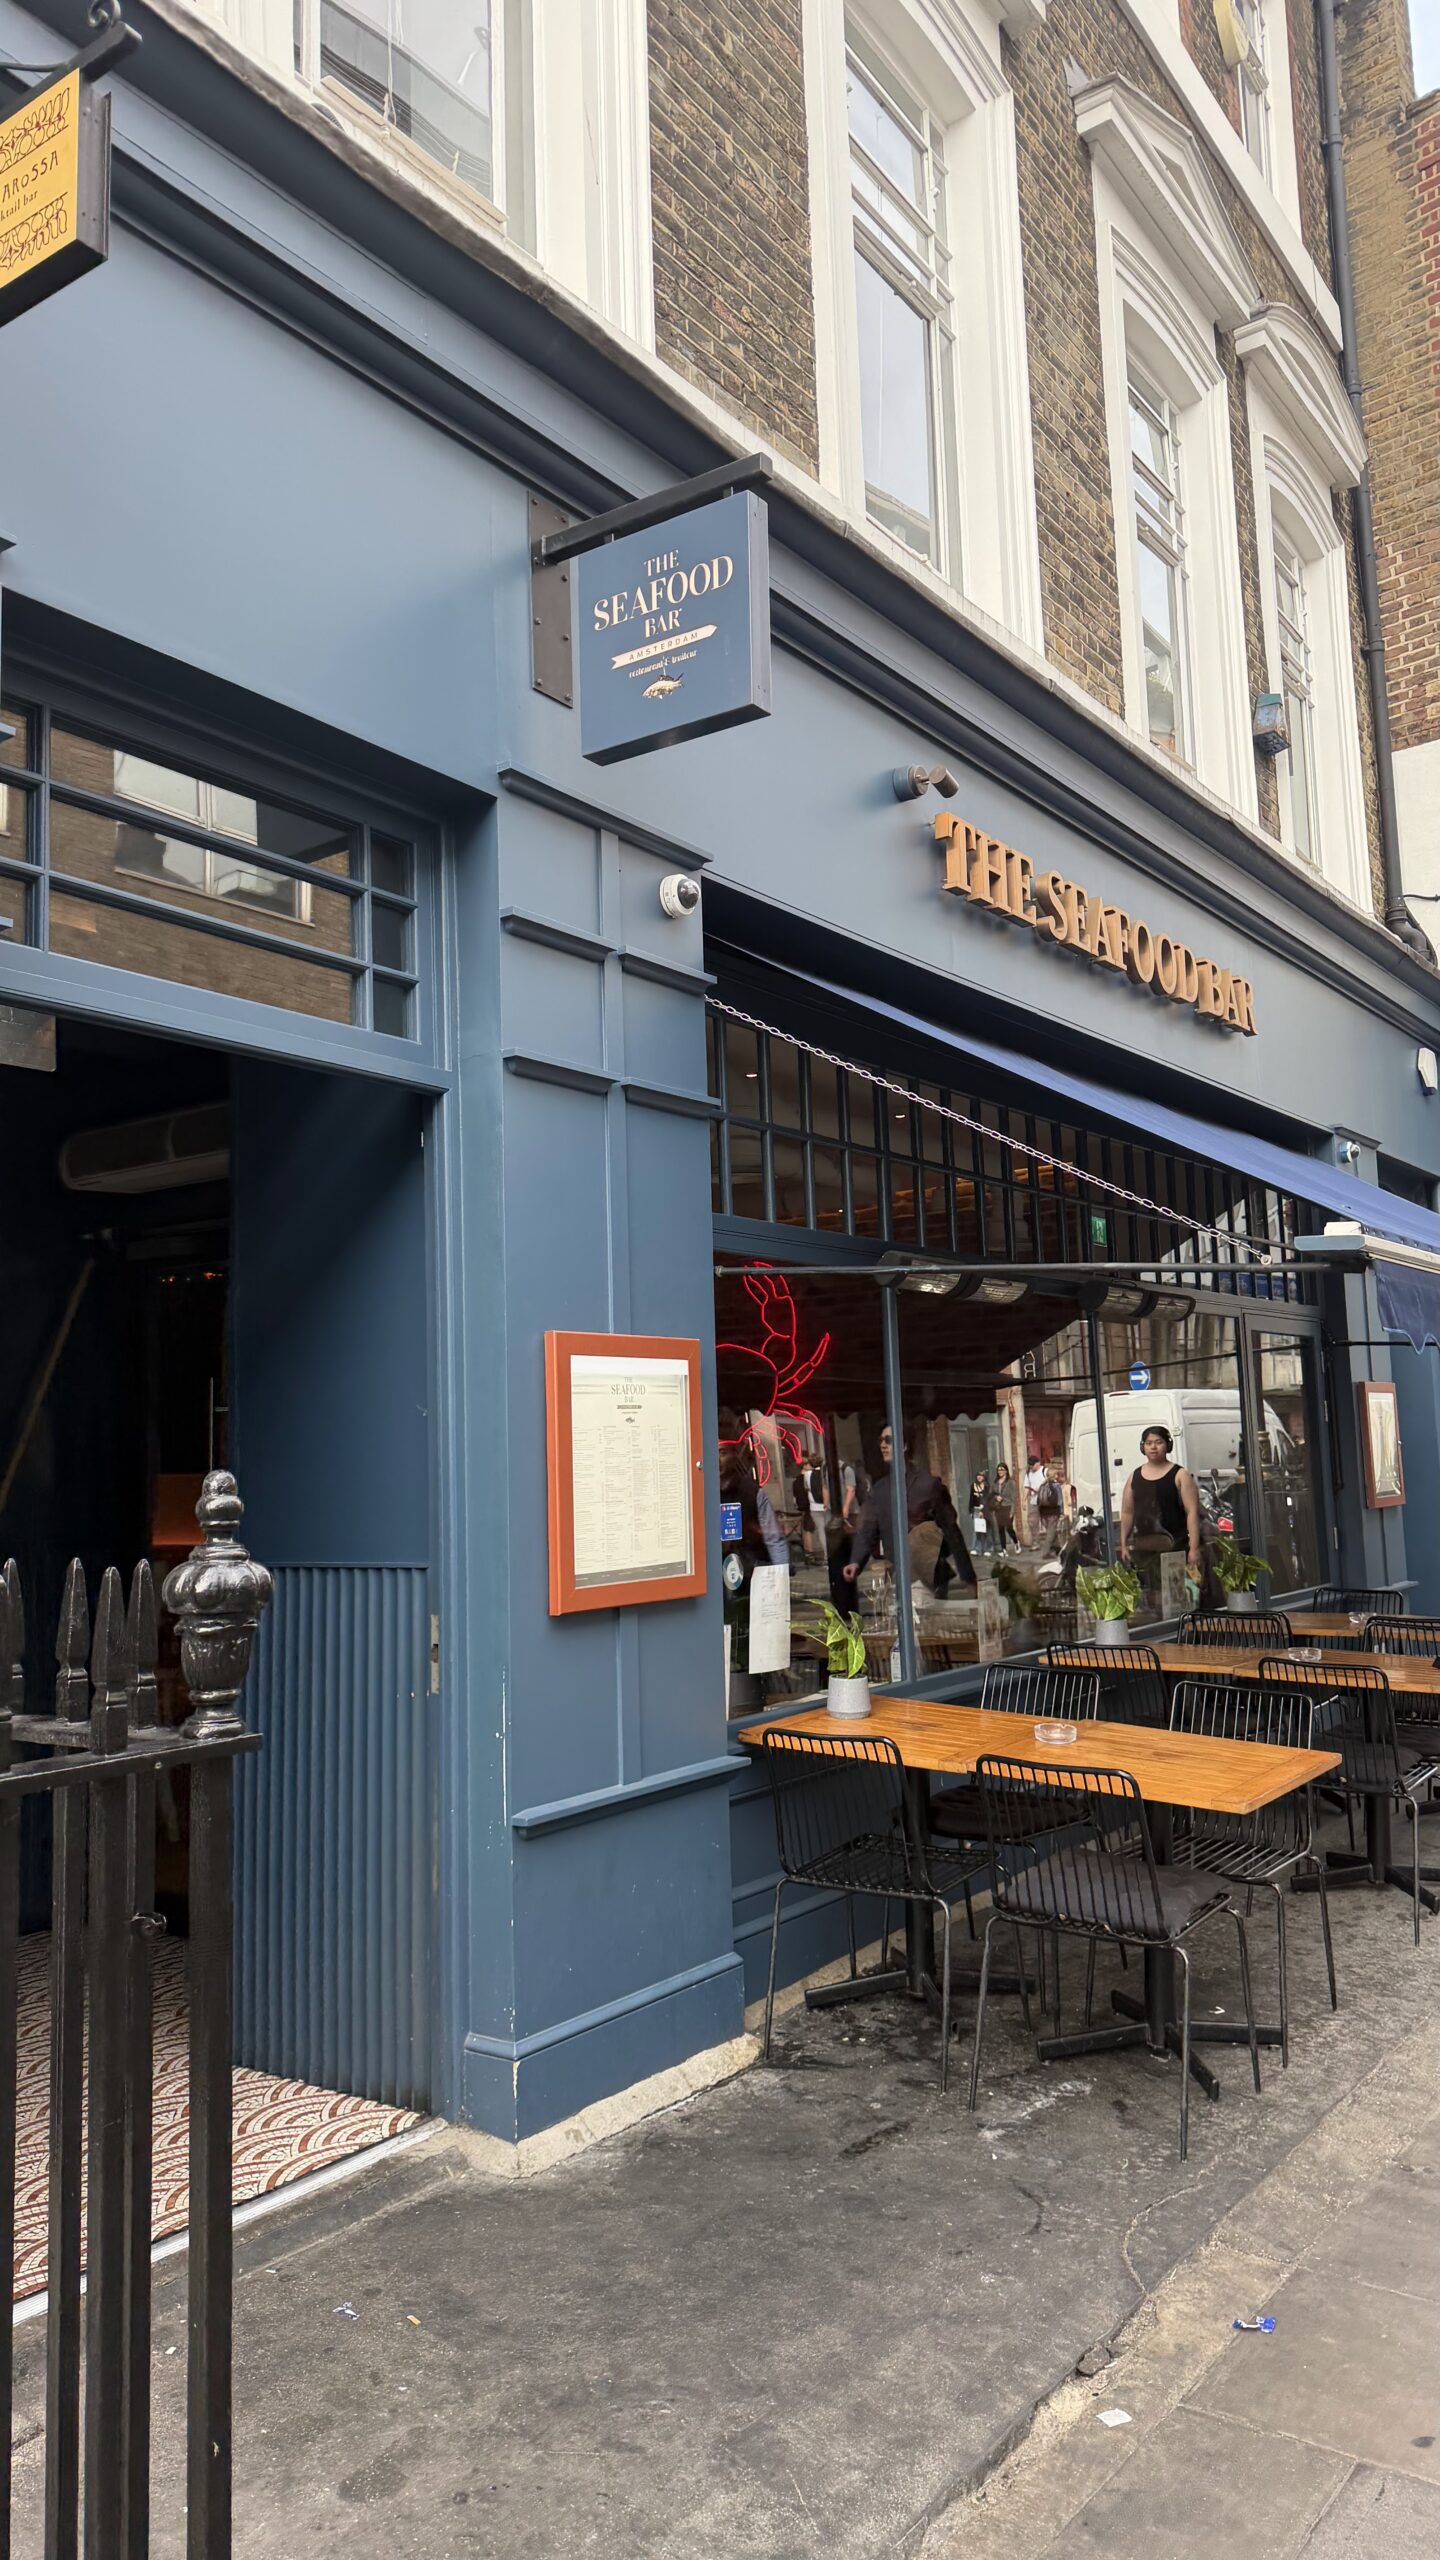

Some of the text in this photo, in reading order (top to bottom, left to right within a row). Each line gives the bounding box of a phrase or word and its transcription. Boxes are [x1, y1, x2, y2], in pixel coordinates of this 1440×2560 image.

[23, 191, 38, 206] bar
[644, 549, 679, 577] THE
[594, 556, 734, 631] SEAFOOD
[645, 608, 682, 638] BAR
[629, 632, 698, 661] AMSTERDAM
[934, 812, 1258, 1036] THE SEAFOOD BAR
[611, 1384, 646, 1395] SEAFOOD
